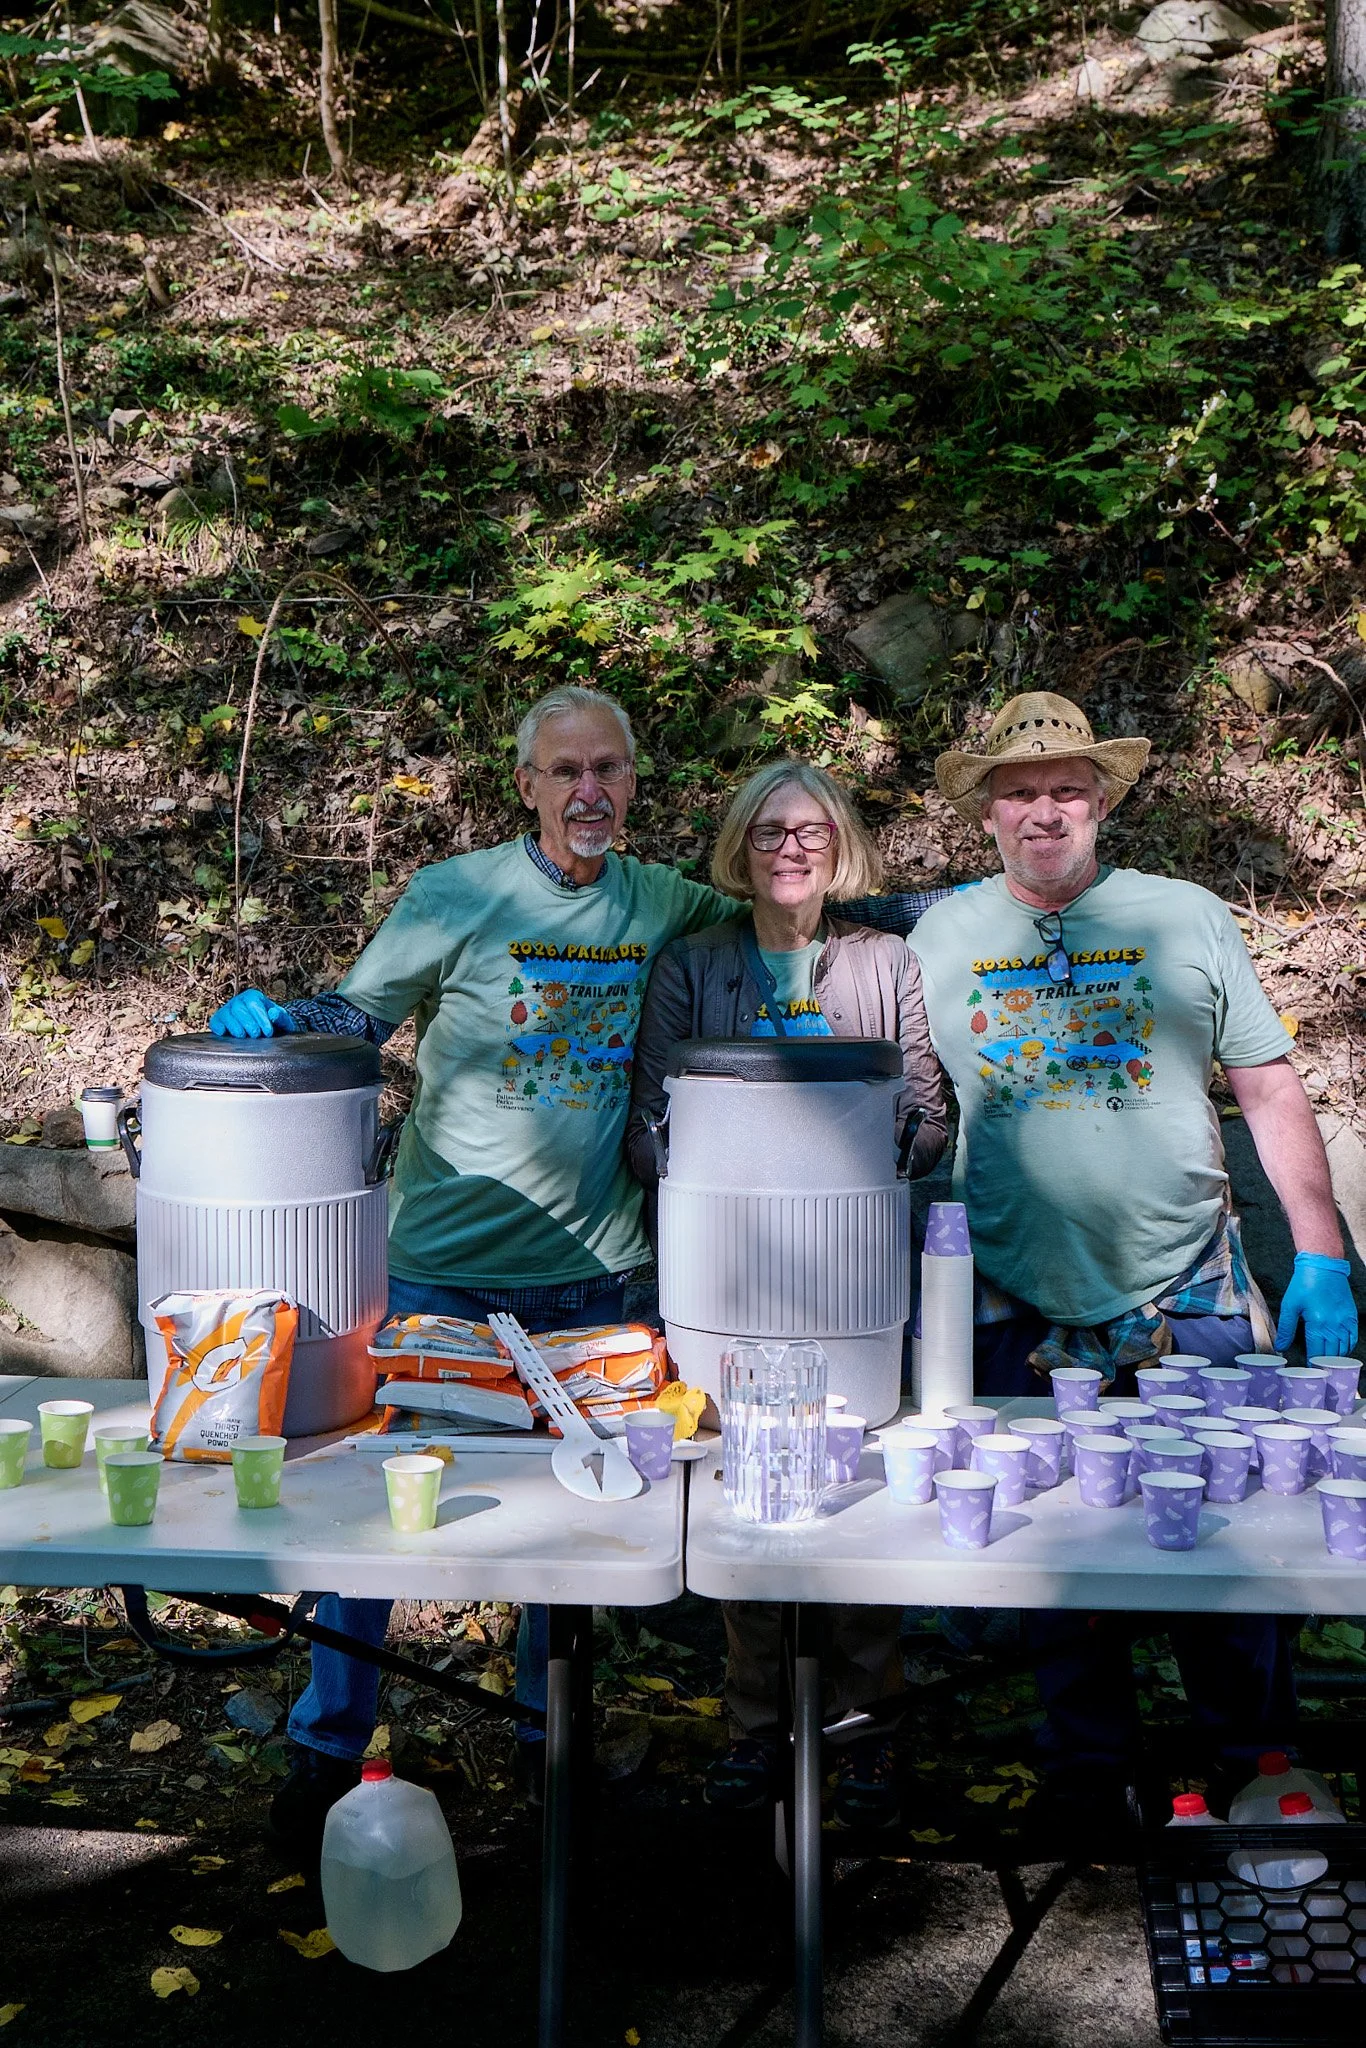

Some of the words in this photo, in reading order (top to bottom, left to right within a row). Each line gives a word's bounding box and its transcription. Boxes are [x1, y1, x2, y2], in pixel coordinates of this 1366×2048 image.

[507, 940, 558, 957] 2026
[971, 956, 1023, 973] 2026
[1034, 946, 1147, 968] PISADES
[545, 989, 564, 1001] 6K
[570, 983, 605, 998] TRAIL
[606, 983, 630, 997] RUN
[1006, 994, 1029, 1006] 6K
[1035, 984, 1081, 1001] TRAIL
[1085, 981, 1121, 996] RUN
[200, 1429, 239, 1440] QUENCHER
[215, 1422, 240, 1432] THIRST
[207, 1439, 229, 1447] POWD
